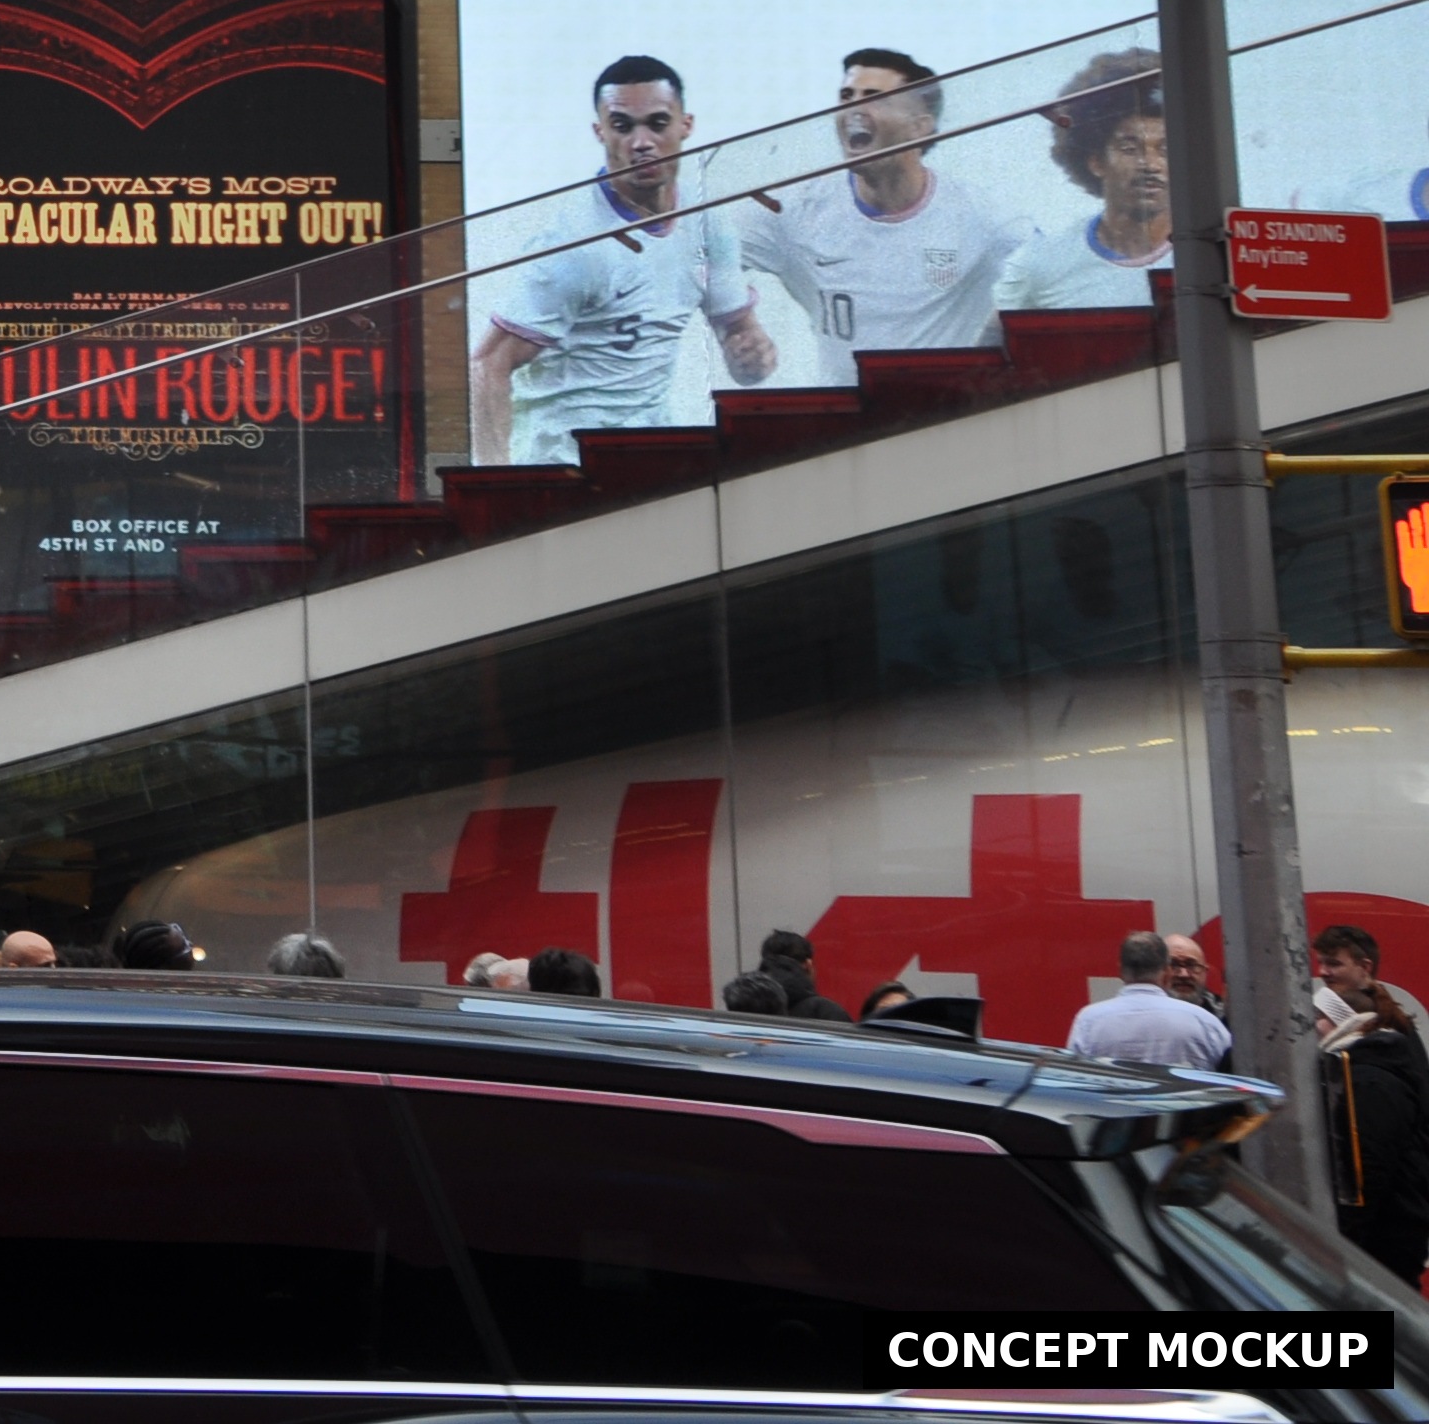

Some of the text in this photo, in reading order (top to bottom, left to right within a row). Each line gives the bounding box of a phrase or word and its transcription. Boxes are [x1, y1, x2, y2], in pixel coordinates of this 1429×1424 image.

[222, 176, 337, 195] MOST
[170, 201, 287, 245] NIGHT
[299, 201, 385, 244] OUT!
[1233, 220, 1347, 243] NO STANDING
[1237, 244, 1309, 269] Anytime
[816, 289, 857, 344] 10
[153, 346, 386, 423] ROUGE!
[71, 518, 222, 535] BOX OFFICE AT
[39, 537, 89, 553] 45TH
[93, 537, 119, 553] ST
[123, 537, 167, 554] AND
